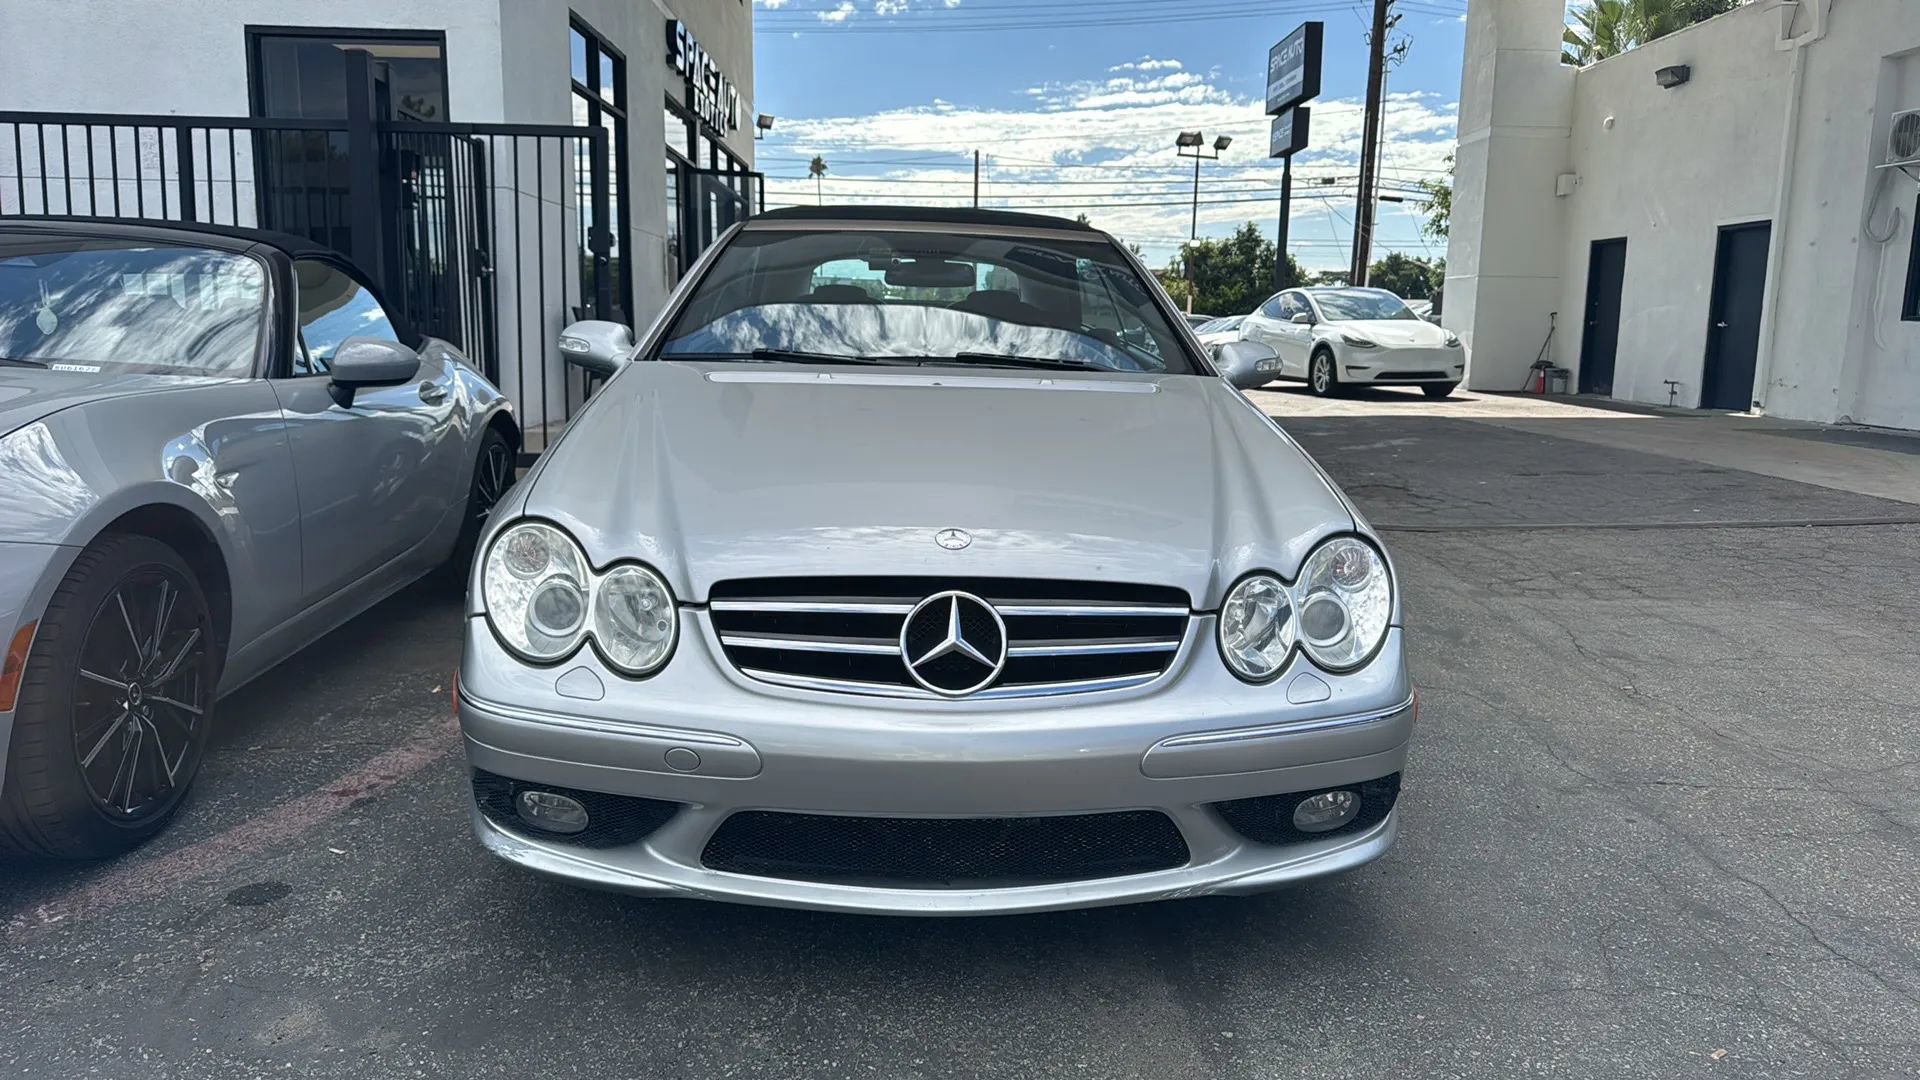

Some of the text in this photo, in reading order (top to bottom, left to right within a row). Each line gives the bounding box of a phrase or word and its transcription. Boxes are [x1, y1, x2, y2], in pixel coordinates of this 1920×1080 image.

[675, 20, 742, 131] SPACE AUTO
[1270, 37, 1304, 73] SPACE AUTO
